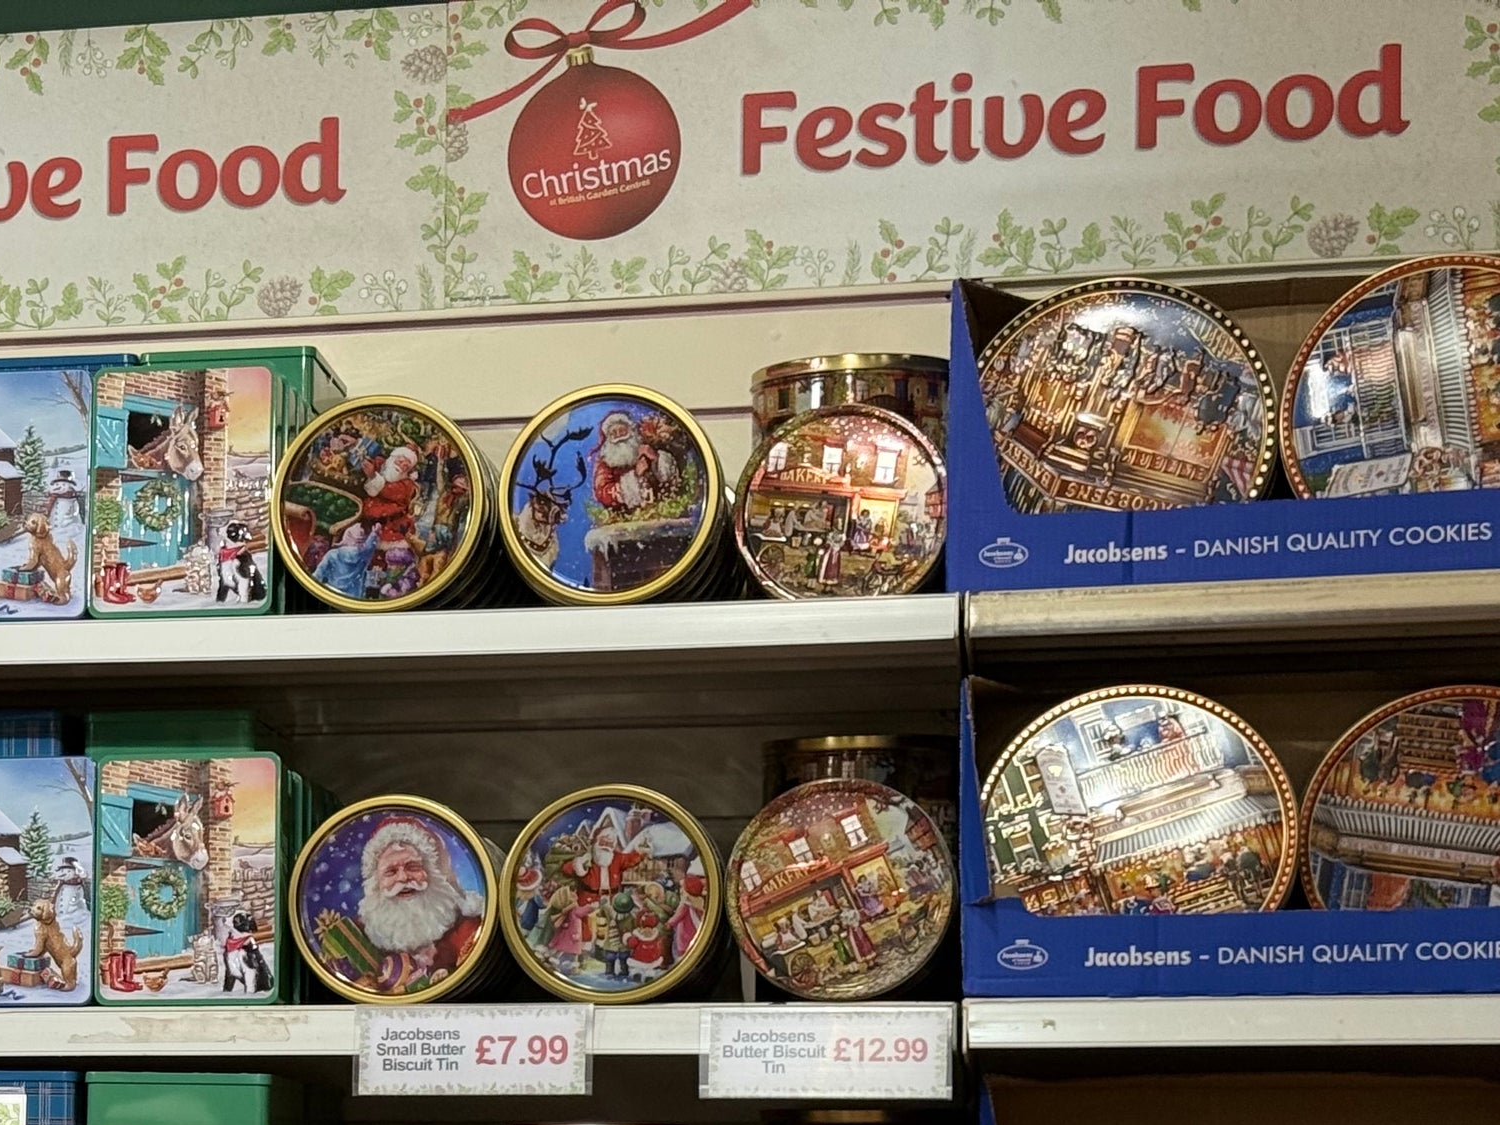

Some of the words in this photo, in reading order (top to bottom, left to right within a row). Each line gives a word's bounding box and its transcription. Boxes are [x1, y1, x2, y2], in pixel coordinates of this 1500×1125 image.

[740, 73, 1107, 177] Festive
[1136, 43, 1411, 151] Food
[108, 116, 346, 216] Food
[522, 149, 671, 199] Christmas
[1002, 438, 1052, 491] BAKERY
[1064, 541, 1168, 565] Jacobsens
[1194, 535, 1279, 559] DANISH
[1287, 528, 1383, 552] QUALITY
[1389, 521, 1492, 547] COOKIES
[1084, 945, 1192, 967] Jacobsens
[1218, 944, 1304, 965] DANISH
[1312, 942, 1409, 963] QUALITY
[382, 1027, 460, 1043] Jacobsens
[733, 1029, 815, 1045] Jacobsens
[376, 1042, 416, 1056] Small
[420, 1042, 465, 1056] Butter
[475, 1034, 568, 1066] £7.99
[722, 1044, 768, 1059] Butter
[772, 1043, 826, 1059] Biscuit
[833, 1037, 928, 1064] £12.99
[382, 1057, 431, 1071] Biscuit
[436, 1057, 459, 1071] Tin
[762, 1060, 785, 1074] Tin
